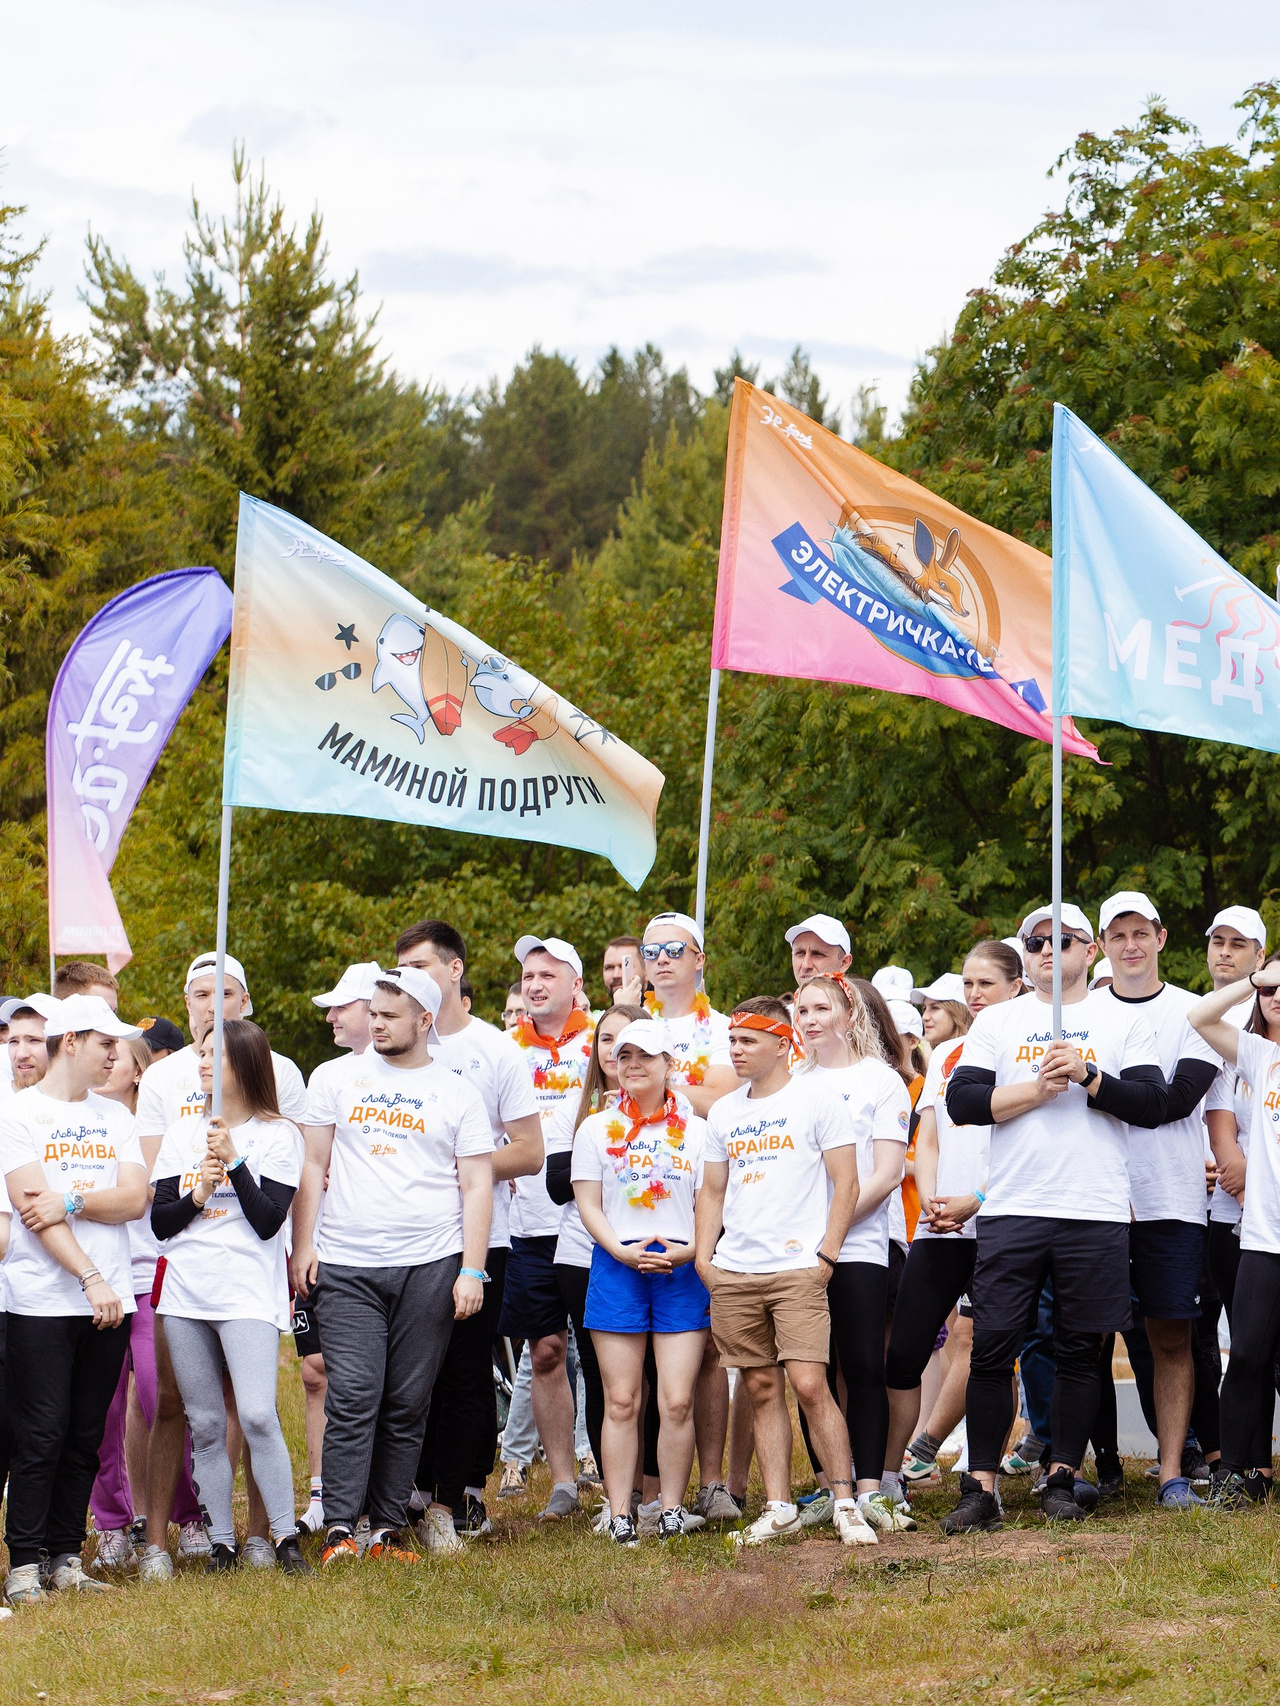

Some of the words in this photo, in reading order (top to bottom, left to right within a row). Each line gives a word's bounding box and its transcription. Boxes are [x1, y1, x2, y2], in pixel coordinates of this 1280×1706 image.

[318, 722, 468, 808] МАМИНОЙ
[478, 774, 606, 817] ПОДРУГИ
[361, 1092, 394, 1106] Лови
[387, 1093, 423, 1109] Волну
[349, 1106, 425, 1134] ДРАЙВА
[51, 1127, 79, 1140] Лови
[76, 1126, 108, 1141] Волну
[731, 1125, 757, 1138] Лови
[44, 1140, 118, 1162] ДРАЙВА
[727, 1134, 795, 1159] ДРАЙВА
[614, 1154, 693, 1174] РАВА
